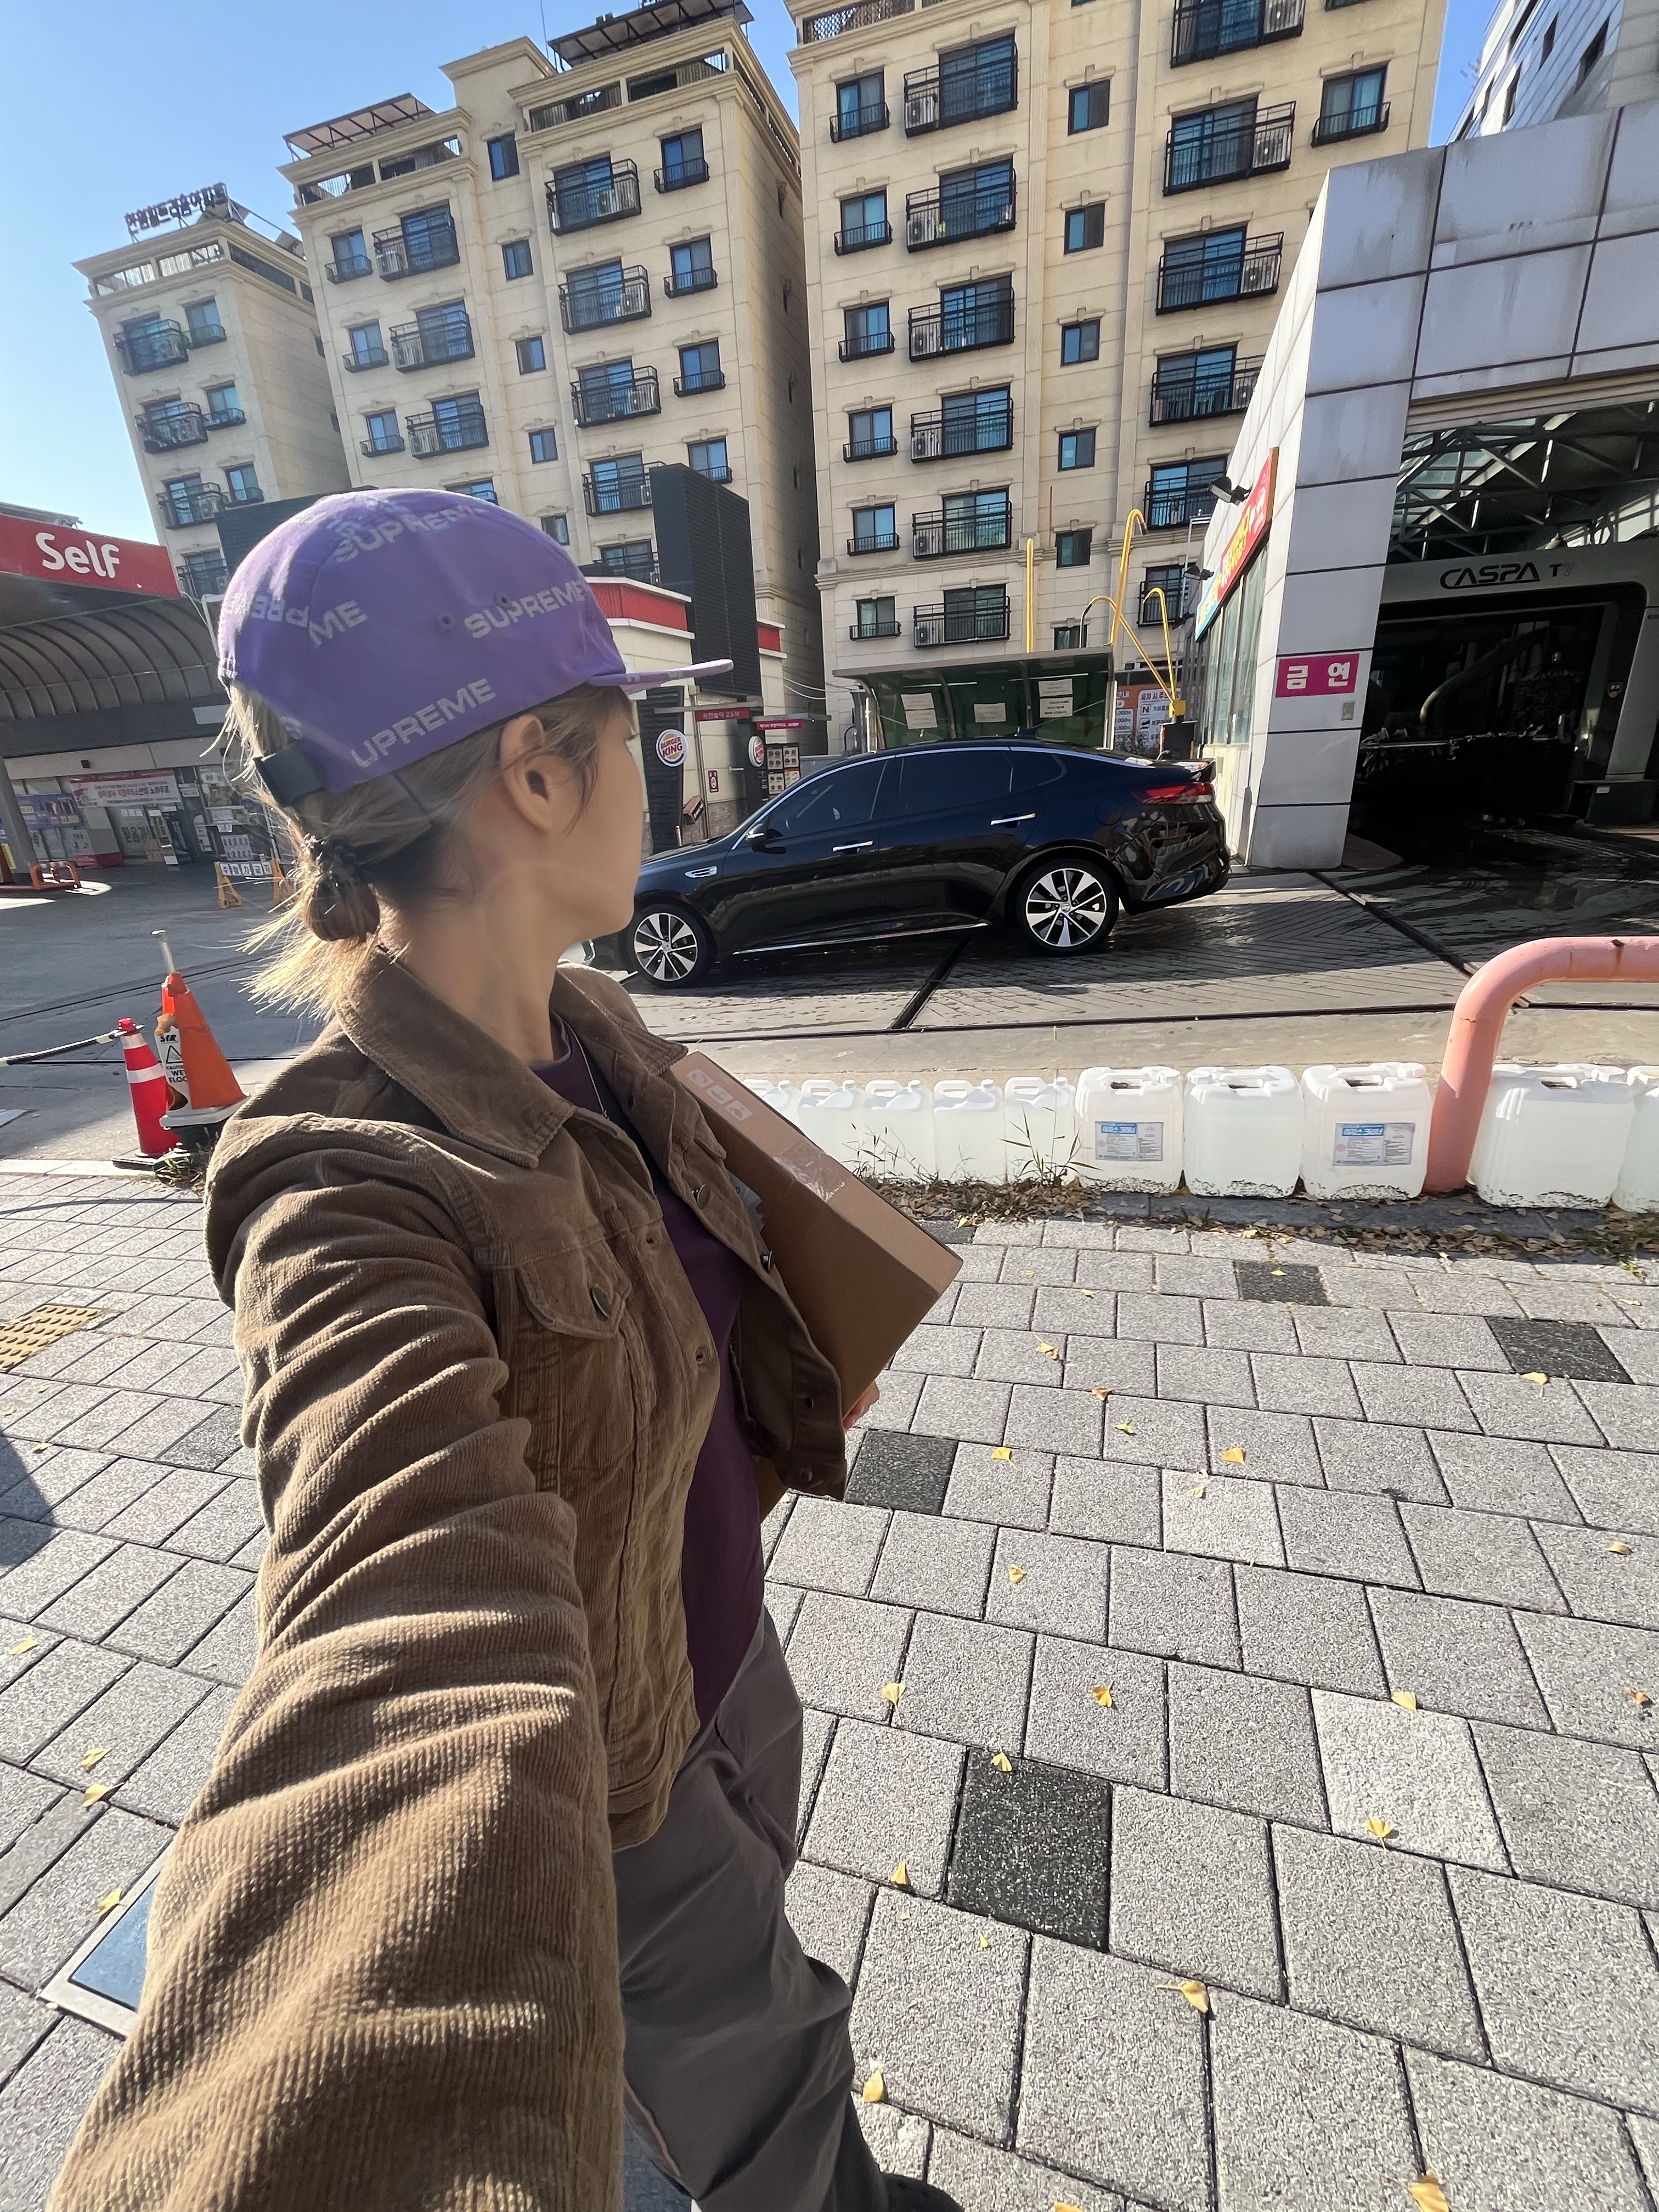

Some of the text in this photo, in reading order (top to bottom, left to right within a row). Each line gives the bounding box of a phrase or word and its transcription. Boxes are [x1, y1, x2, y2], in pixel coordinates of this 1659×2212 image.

[35, 532, 120, 578] Self
[334, 505, 489, 563] SUPREM
[1440, 562, 1541, 589] CASPA
[464, 580, 586, 639] SUPREME
[351, 677, 497, 768] UPREME
[660, 736, 681, 748] BURGER
[662, 743, 683, 758] KING
